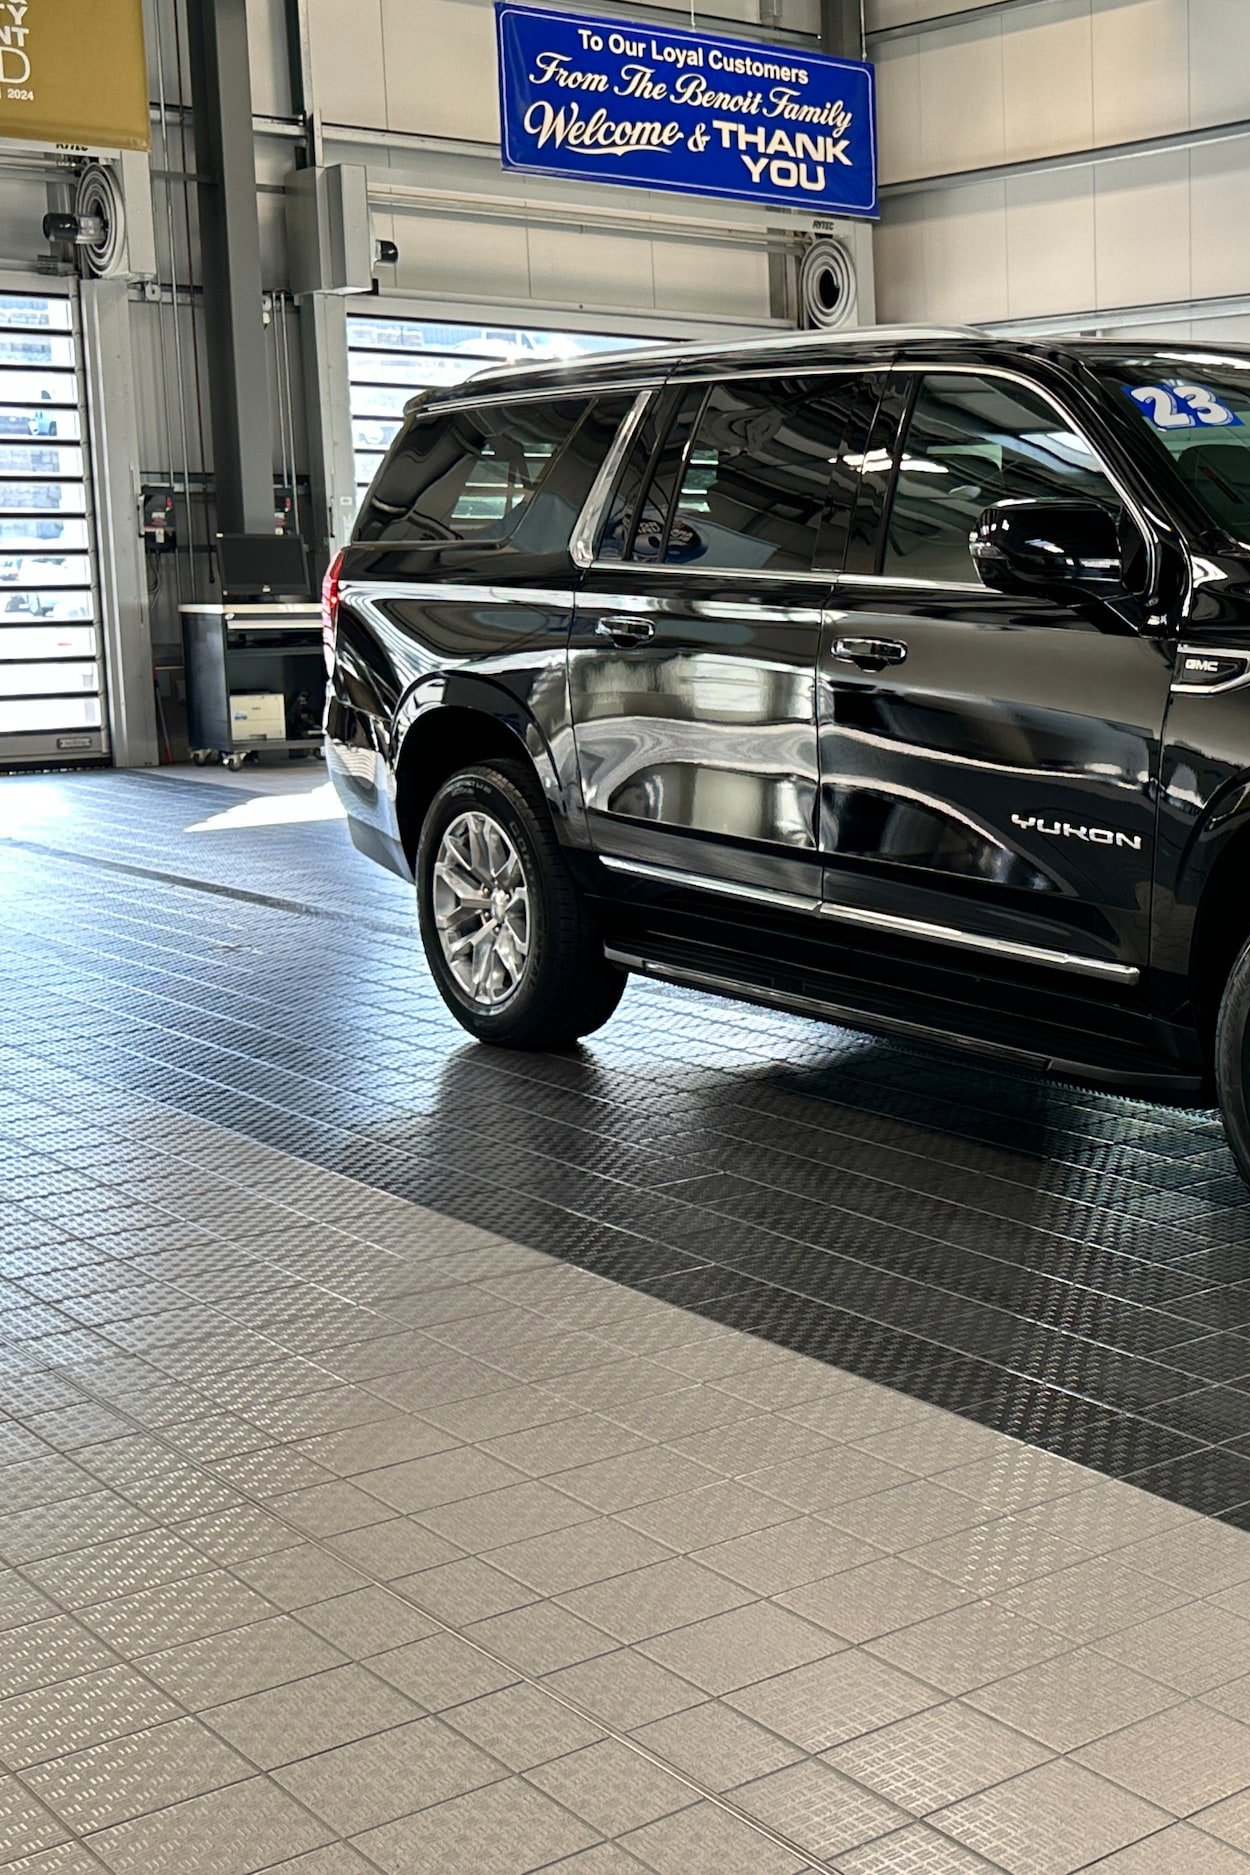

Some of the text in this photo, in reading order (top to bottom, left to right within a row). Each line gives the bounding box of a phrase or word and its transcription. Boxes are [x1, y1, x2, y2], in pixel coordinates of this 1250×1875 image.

[578, 29, 809, 84] To Our Loyal Customers
[7, 88, 34, 101] 2024
[528, 51, 853, 138] From The Benoit Family
[523, 100, 854, 166] Welcome & THANK
[741, 154, 827, 192] YOU
[1130, 386, 1234, 426] 23
[1184, 658, 1219, 672] GMC
[1011, 813, 1142, 850] YUKON
